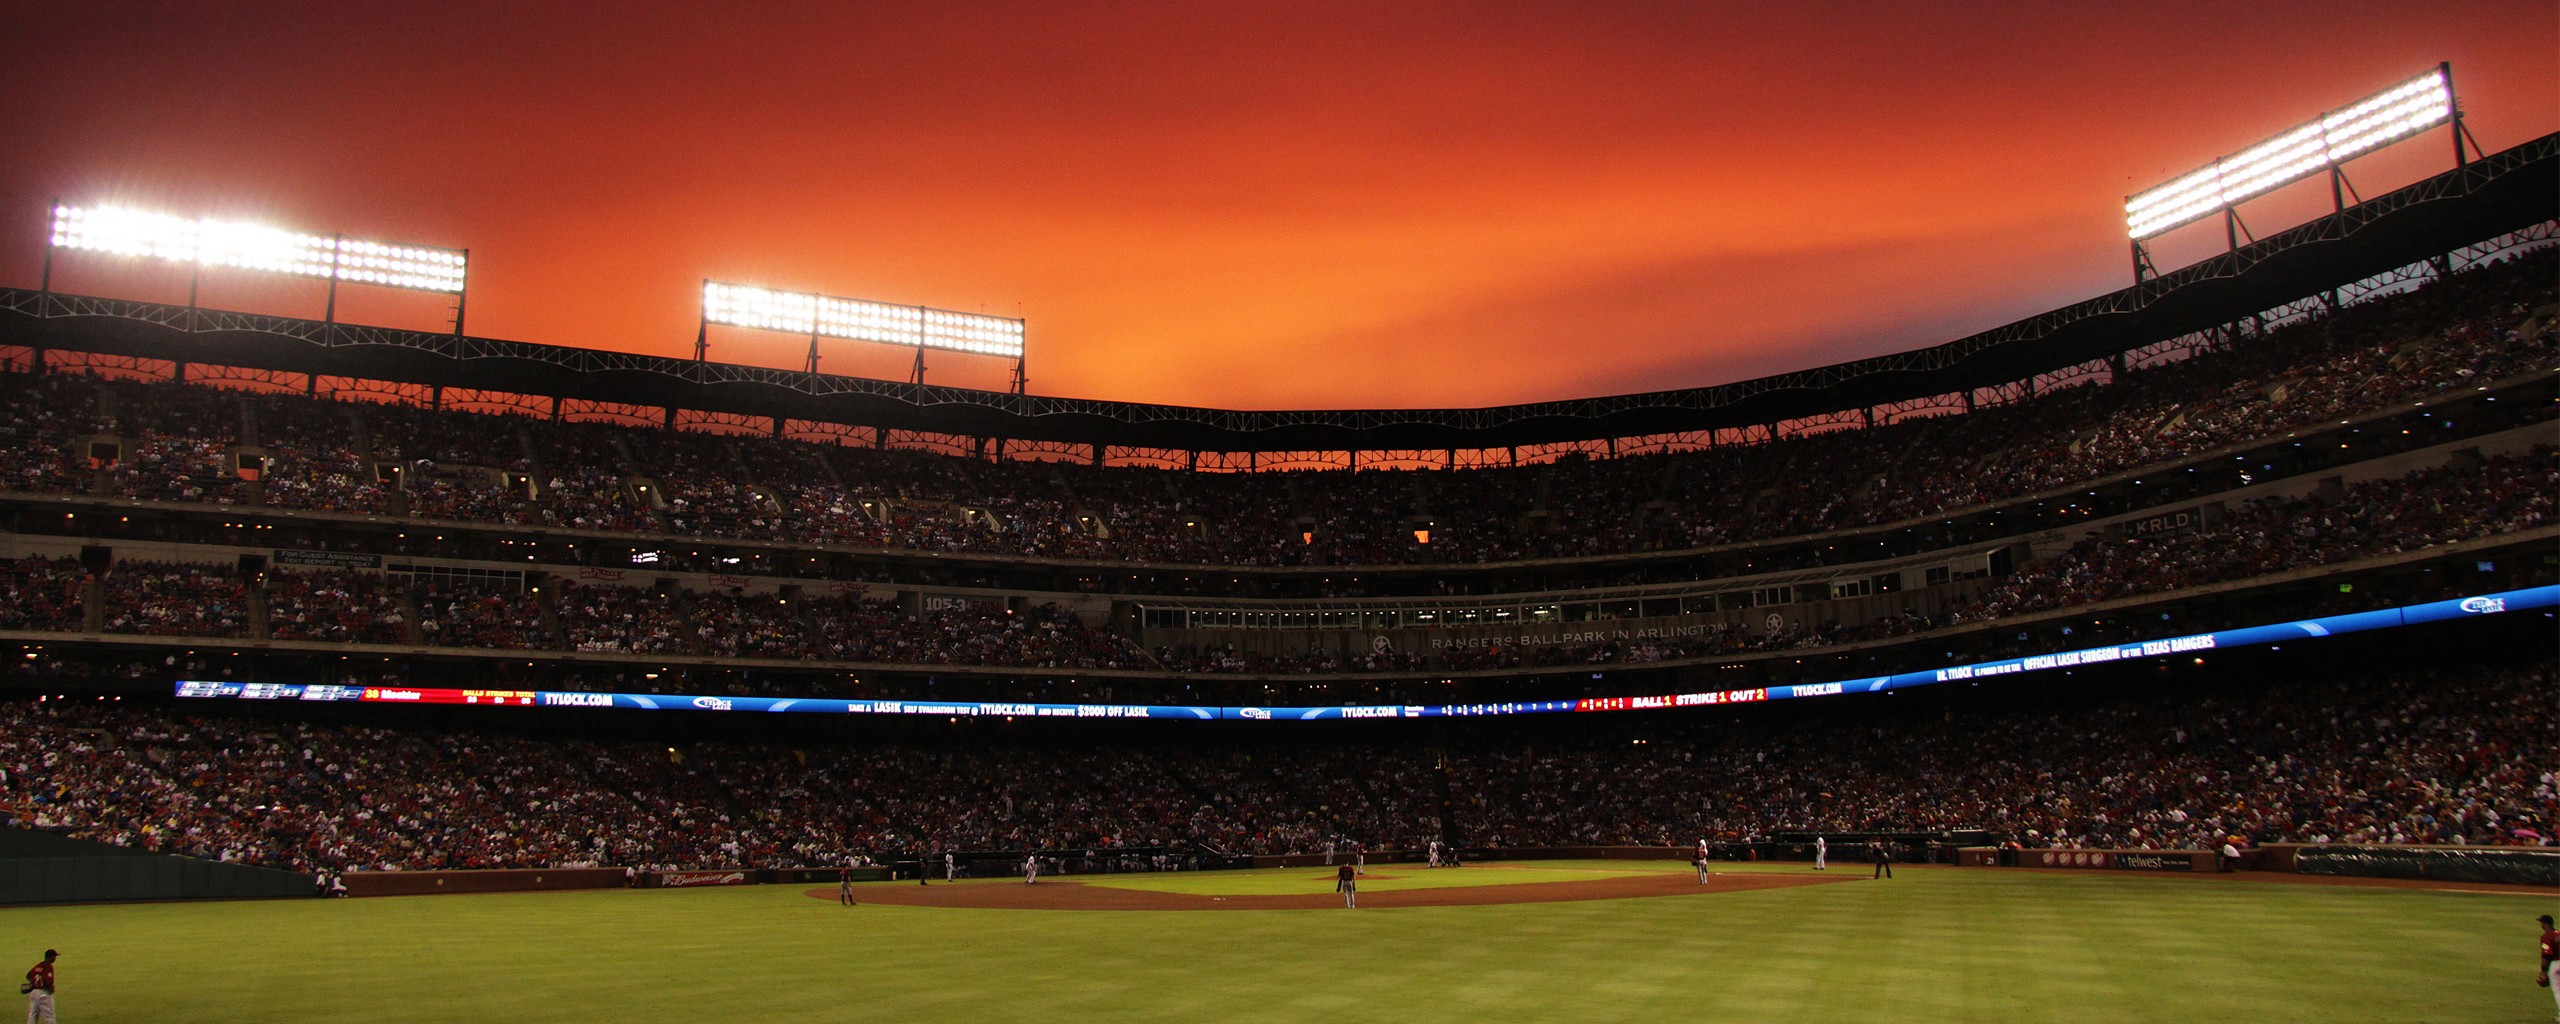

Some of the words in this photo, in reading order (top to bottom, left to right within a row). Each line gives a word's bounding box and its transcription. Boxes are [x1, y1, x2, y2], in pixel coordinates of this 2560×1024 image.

[2137, 513, 2189, 535] KRLD
[300, 551, 326, 560] GUEST
[328, 553, 375, 562] ASSISTANCE
[972, 600, 1000, 613] FAN
[1432, 637, 1513, 649] RANGERS
[1520, 631, 1606, 646] BALLPARK
[1612, 629, 1629, 640] IN
[1637, 623, 1729, 639] ARLINGTON
[1937, 670, 1948, 682] DR.
[1948, 667, 1972, 680] TYLOCK
[1997, 665, 2003, 674] TO
[2011, 663, 2021, 672] THE
[2023, 655, 2057, 671] OFFICIAL
[2056, 651, 2080, 666] LASIK
[2081, 647, 2119, 664] SURGEON
[2121, 650, 2128, 658] OF
[2129, 648, 2142, 657] THE
[2142, 640, 2170, 656] TEXAS
[2171, 634, 2216, 652] RANGERS
[366, 689, 379, 698] 38
[1792, 682, 1842, 696] TYLOCK.COM
[545, 693, 613, 706] TYLOCK.COM
[1632, 697, 1663, 708] BALL
[1664, 695, 1671, 706] 1
[1675, 693, 1717, 706] STRIKE
[1719, 692, 1726, 702] 1
[1730, 690, 1755, 701] OUT
[1756, 688, 1765, 699] 2
[848, 704, 864, 712] TAKE
[875, 701, 902, 713] LASIK
[904, 705, 917, 713] SELF
[957, 706, 970, 714] TEST
[971, 707, 978, 716] @
[980, 704, 1035, 715] TYLOCK.COM
[1052, 708, 1075, 716] RECEIVE
[1078, 705, 1105, 717] $2000
[1107, 706, 1123, 717] OFF
[1341, 706, 1397, 717] TYLOCK.COM
[2127, 854, 2162, 868] telwest
[675, 872, 722, 886] Budweiser
